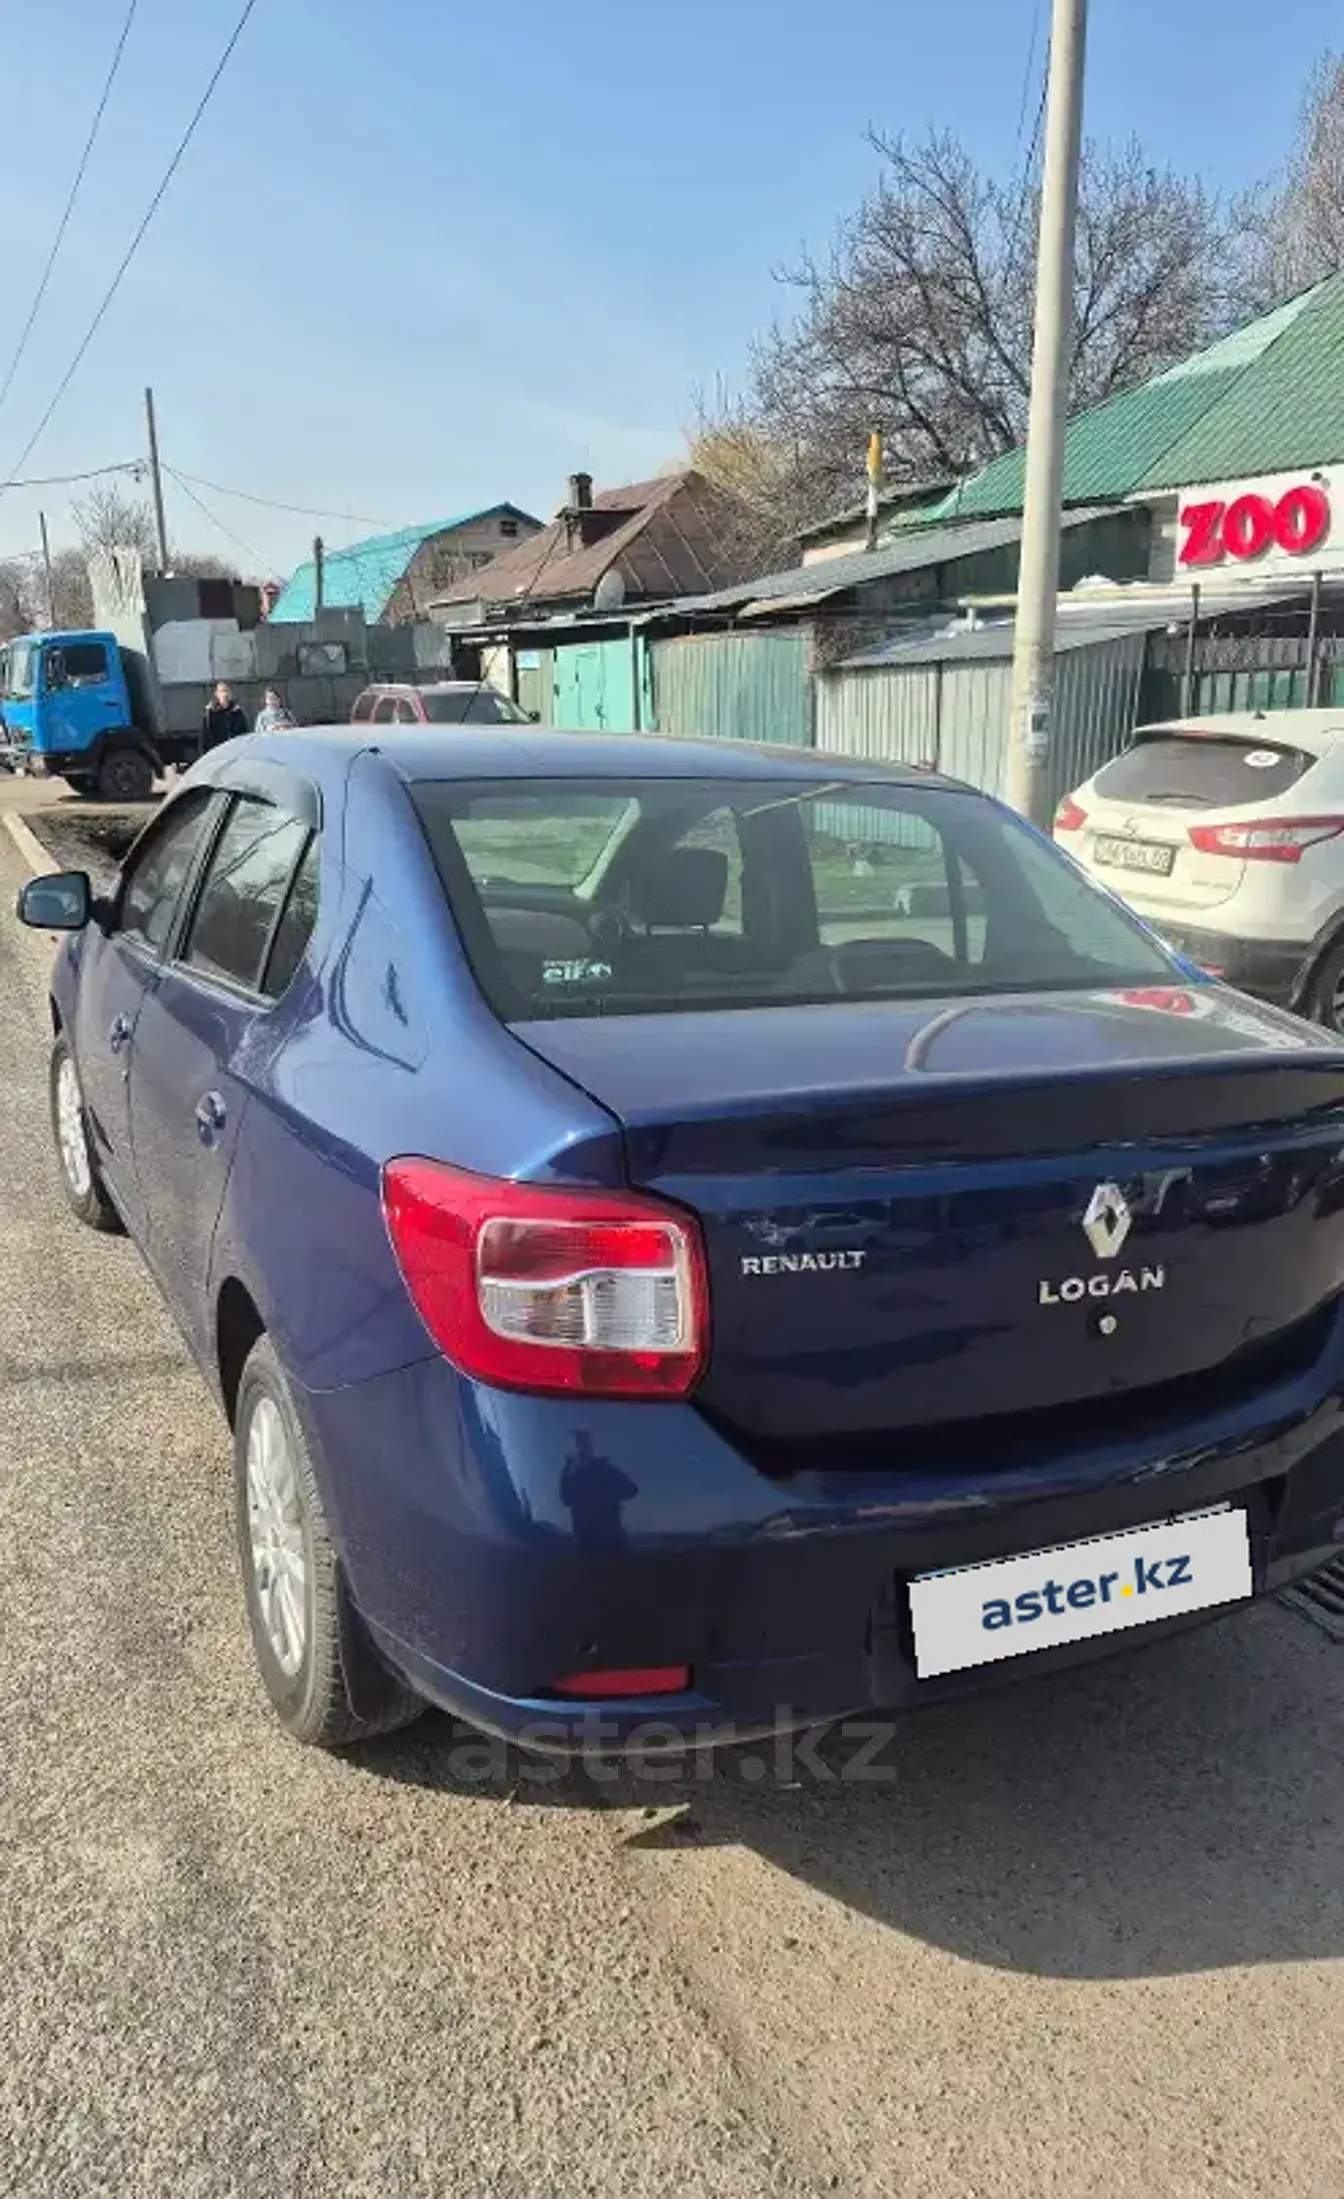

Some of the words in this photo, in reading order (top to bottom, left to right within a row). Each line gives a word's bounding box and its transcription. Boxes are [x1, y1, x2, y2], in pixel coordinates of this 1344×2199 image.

[1179, 486, 1330, 565] ZOO
[741, 1250, 867, 1275] RENAULT
[1039, 1265, 1165, 1304] LOGAN
